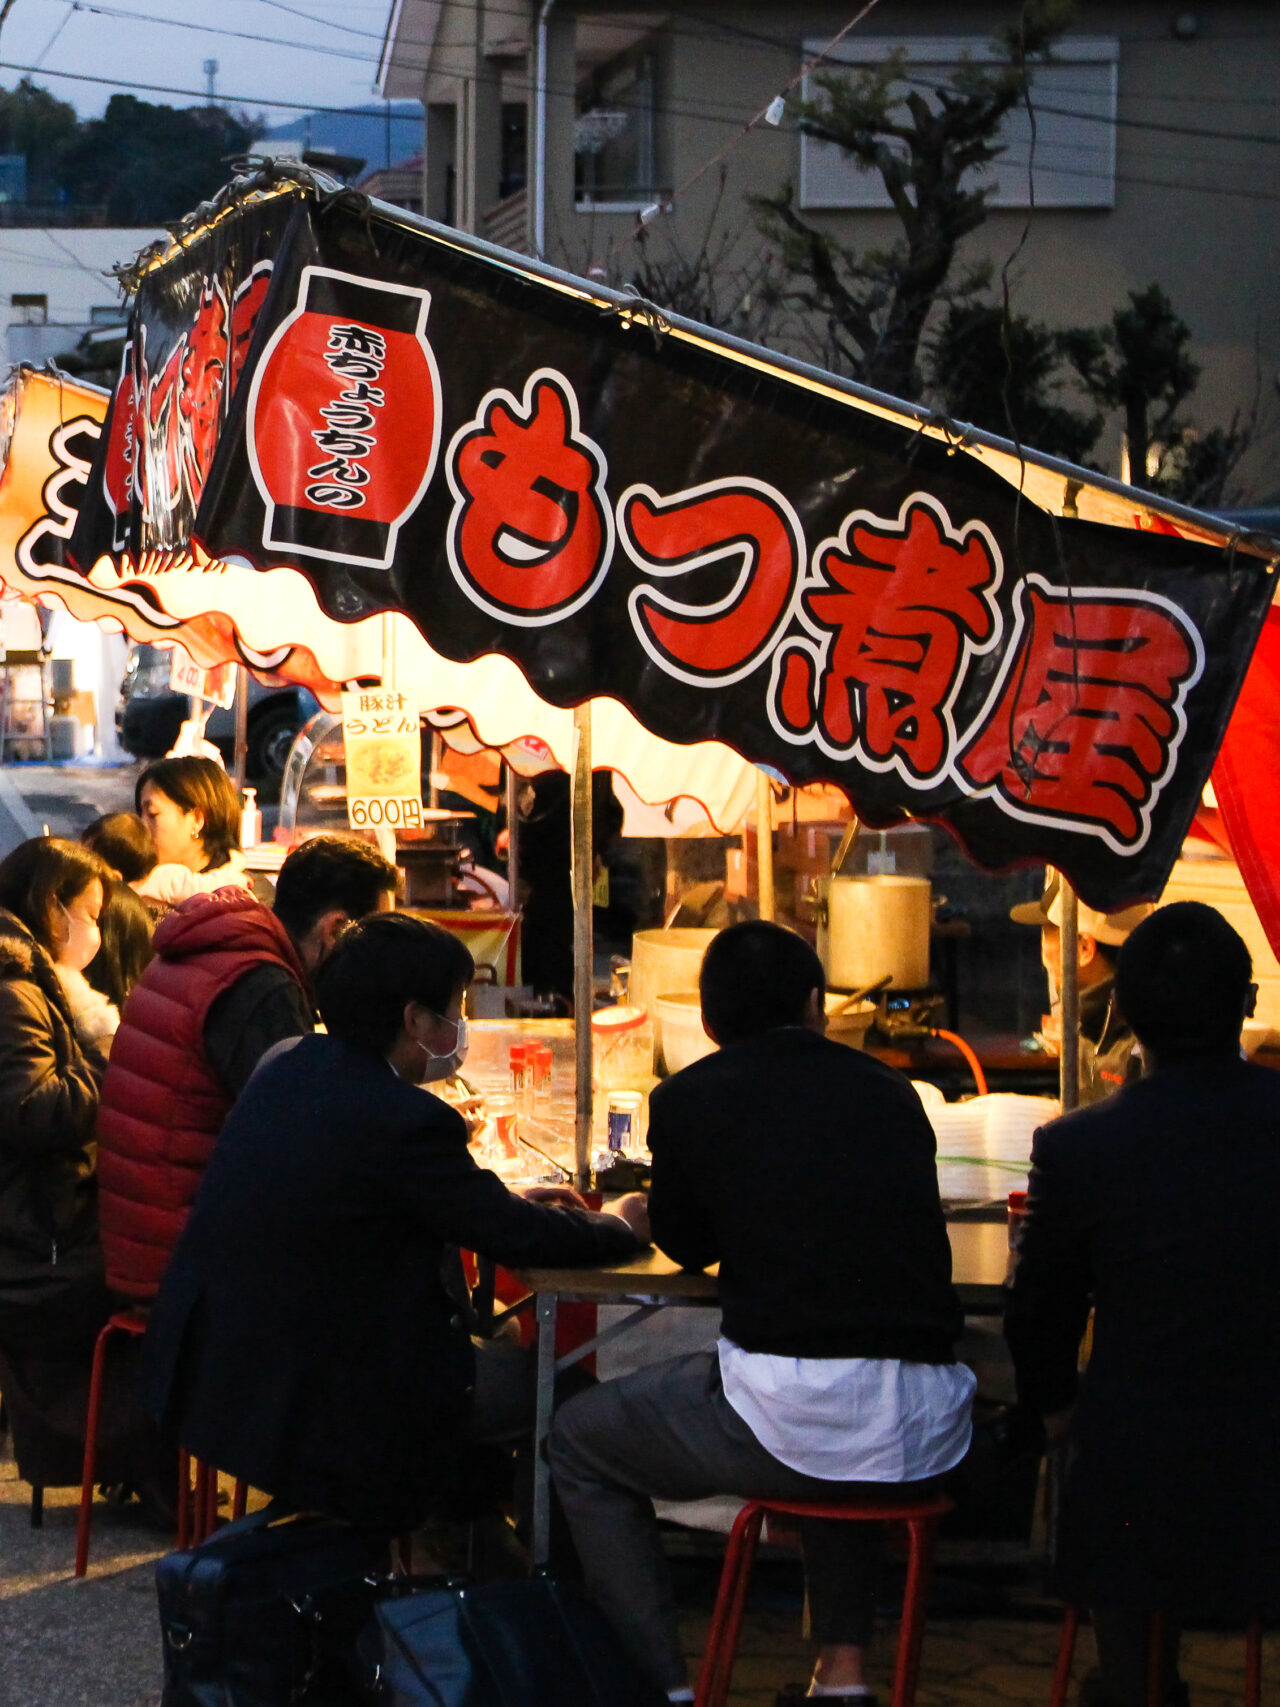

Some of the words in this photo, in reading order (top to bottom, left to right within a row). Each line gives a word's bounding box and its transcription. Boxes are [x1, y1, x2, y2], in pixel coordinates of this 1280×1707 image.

[304, 323, 387, 508] 赤ちょうちんの
[445, 367, 1206, 857] もつ煮屋
[359, 693, 408, 712] 豚汁
[346, 716, 418, 735] うどん
[352, 798, 422, 829] 600円
